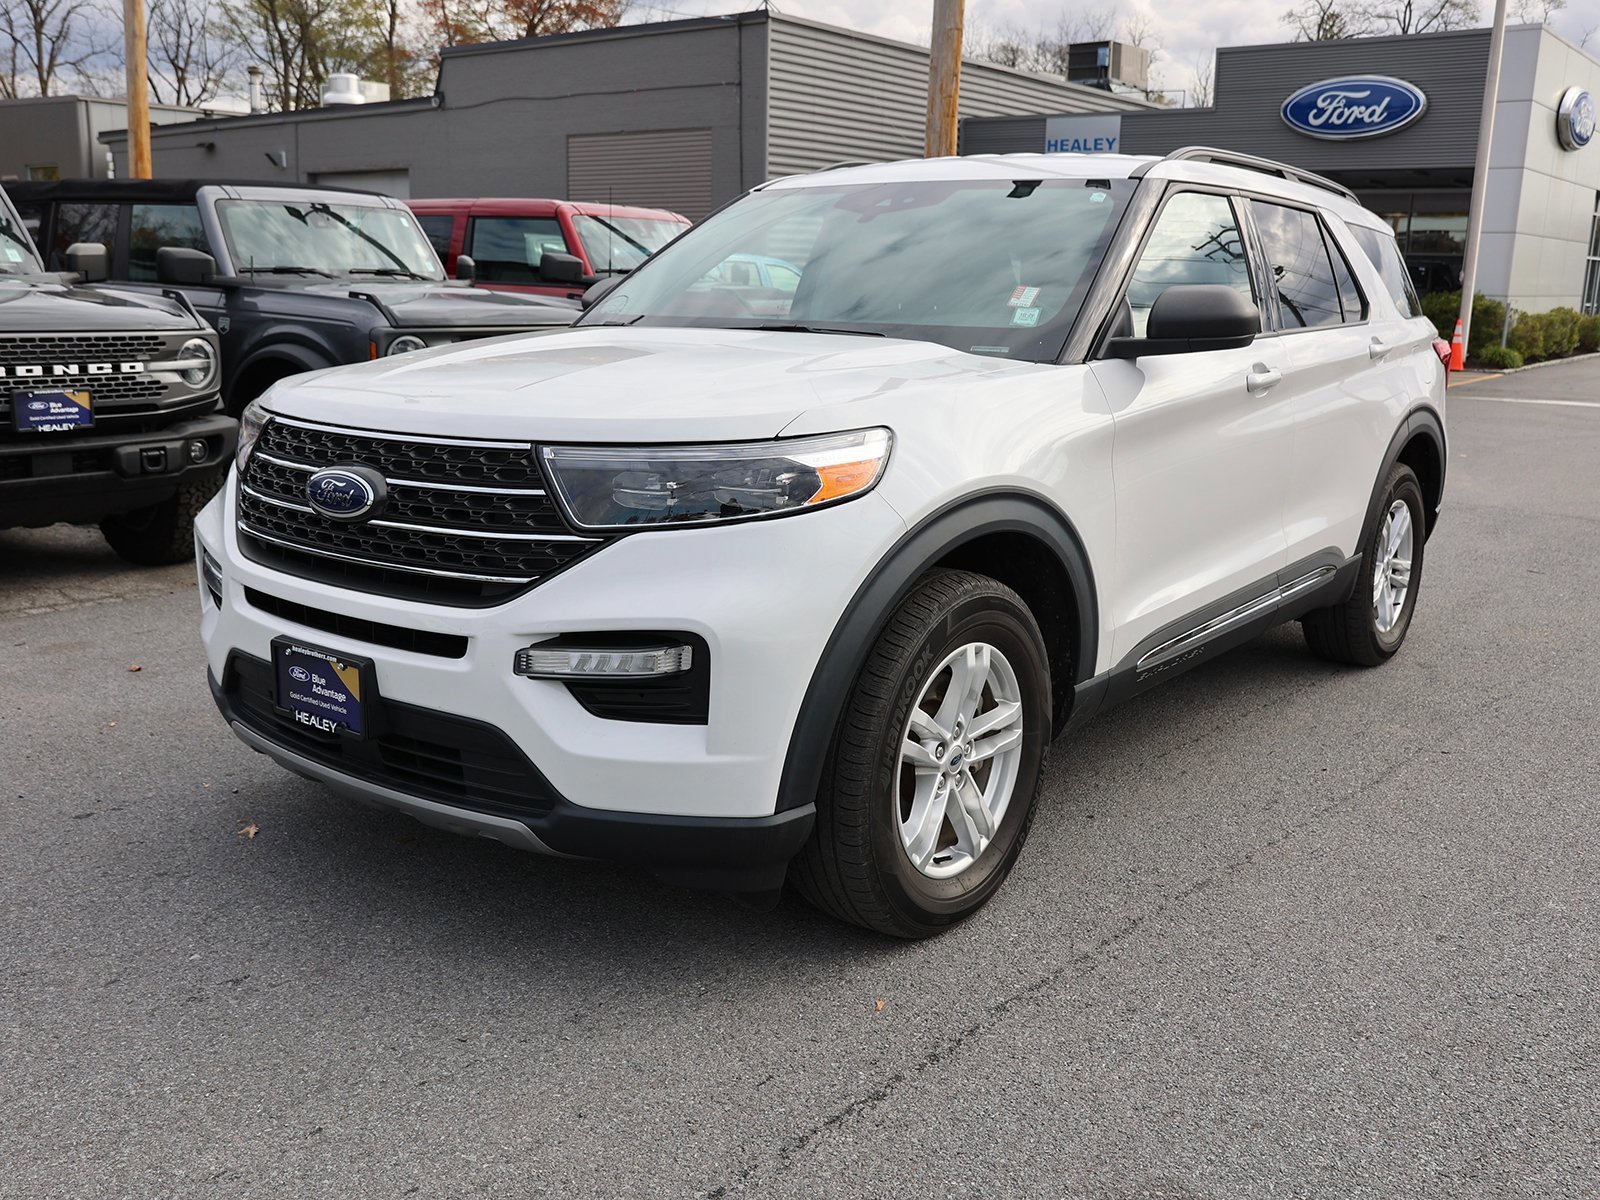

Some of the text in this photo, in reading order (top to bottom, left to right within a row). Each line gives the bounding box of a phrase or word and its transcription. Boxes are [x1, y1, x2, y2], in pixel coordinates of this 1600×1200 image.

[1308, 90, 1391, 126] Ford
[1047, 137, 1117, 152] HEALEY
[0, 362, 144, 377] ONCO
[38, 423, 75, 432] HEALEY
[317, 479, 354, 507] Ford
[291, 645, 338, 663] healeybrothers.com
[311, 673, 326, 686] Blue
[312, 684, 347, 703] Advantage
[289, 691, 348, 715] Gold Certified Used Vehicle
[295, 710, 337, 733] HEALEY
